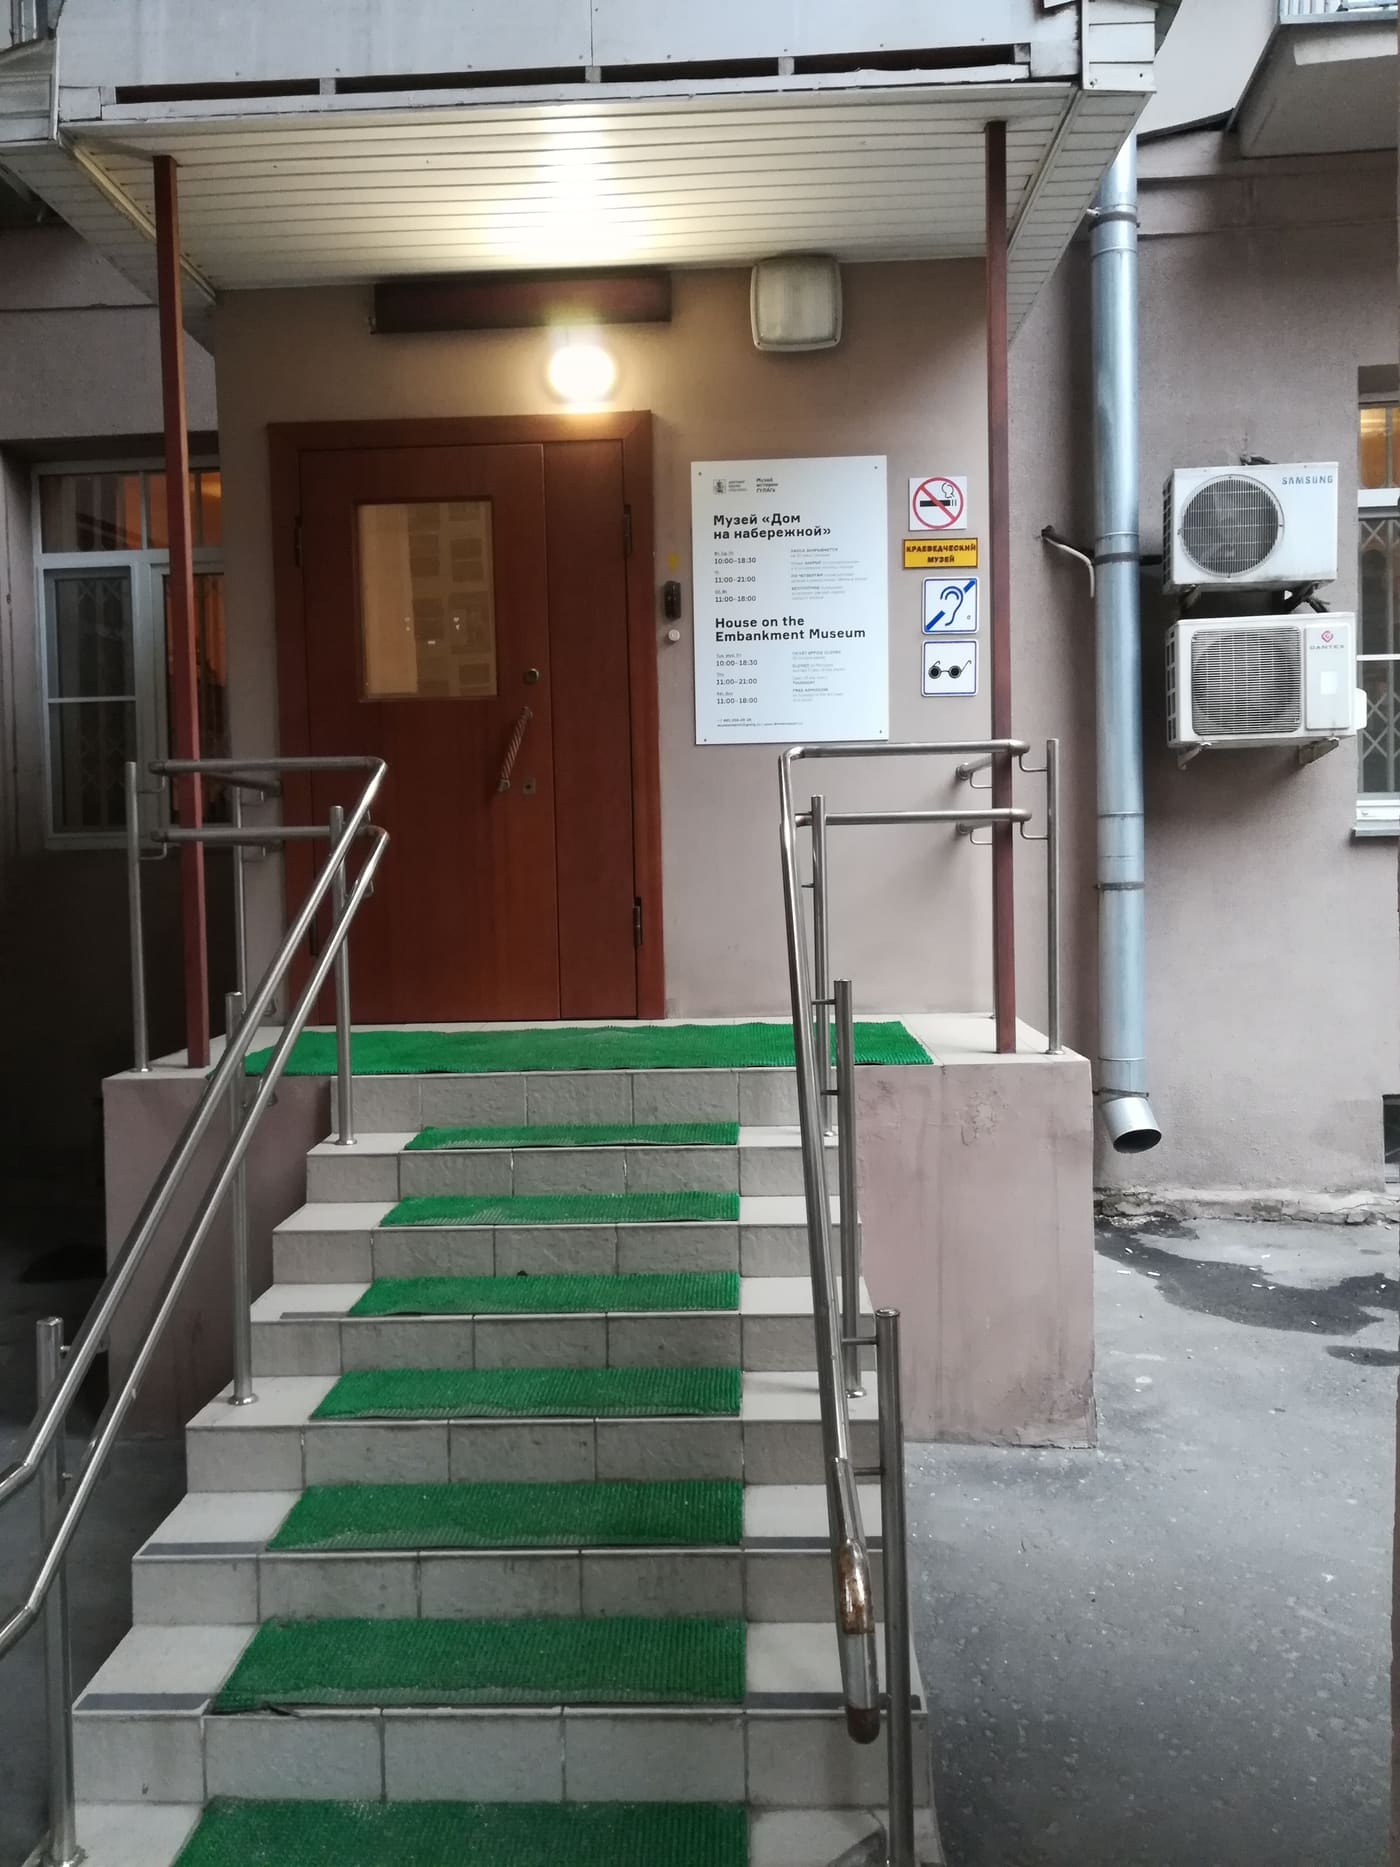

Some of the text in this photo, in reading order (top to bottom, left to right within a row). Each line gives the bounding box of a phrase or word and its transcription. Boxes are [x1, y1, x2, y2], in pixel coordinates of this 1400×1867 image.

[1281, 475, 1333, 485] SAMSUNG
[713, 513, 801, 528] Музей «Дом
[714, 526, 831, 540] на набережной»
[906, 543, 976, 553] КРАЕВЕДЧЕСКИЙ
[927, 555, 955, 563] МУЗЕЙ
[715, 616, 805, 628] House on the
[715, 628, 866, 642] Embankment Museum
